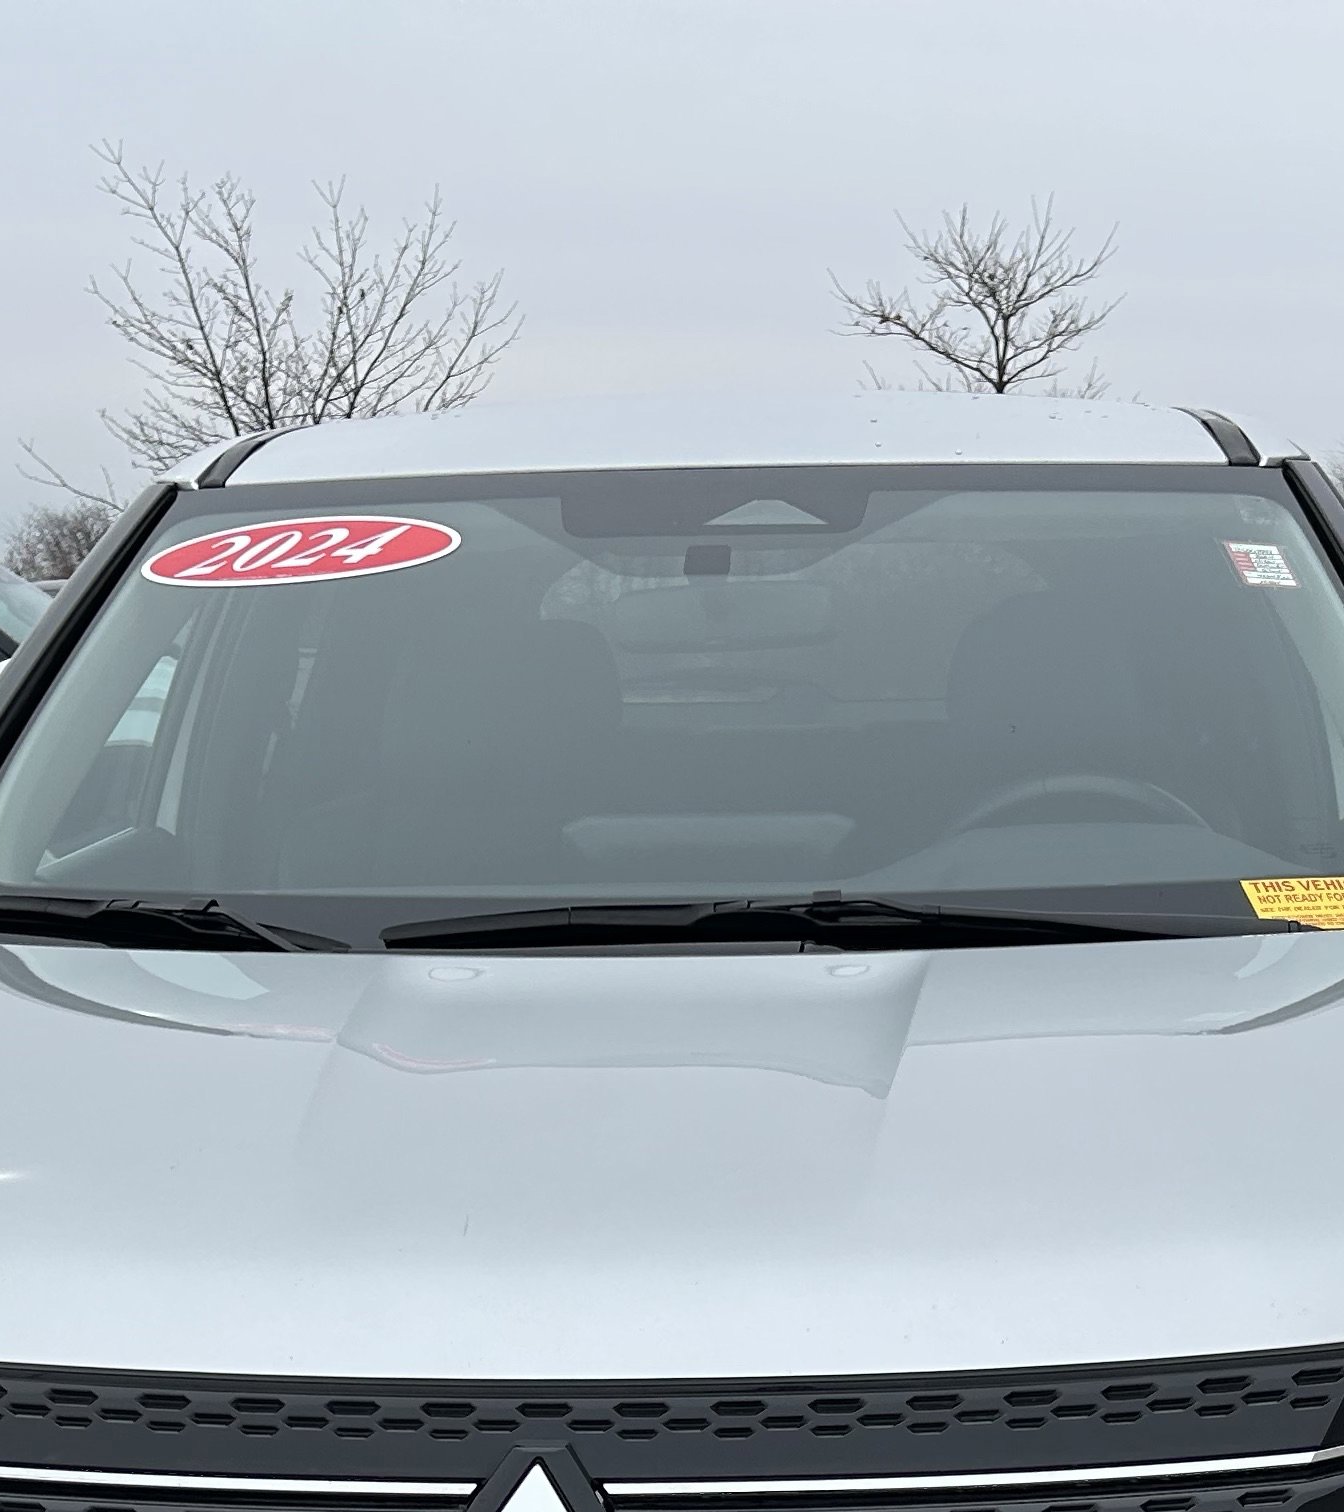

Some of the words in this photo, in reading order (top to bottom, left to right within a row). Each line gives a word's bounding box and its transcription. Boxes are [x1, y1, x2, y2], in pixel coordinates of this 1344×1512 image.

[173, 525, 412, 578] 2024
[1249, 880, 1295, 894] THIS
[1257, 894, 1283, 905] NOT
[1285, 891, 1323, 904] READY
